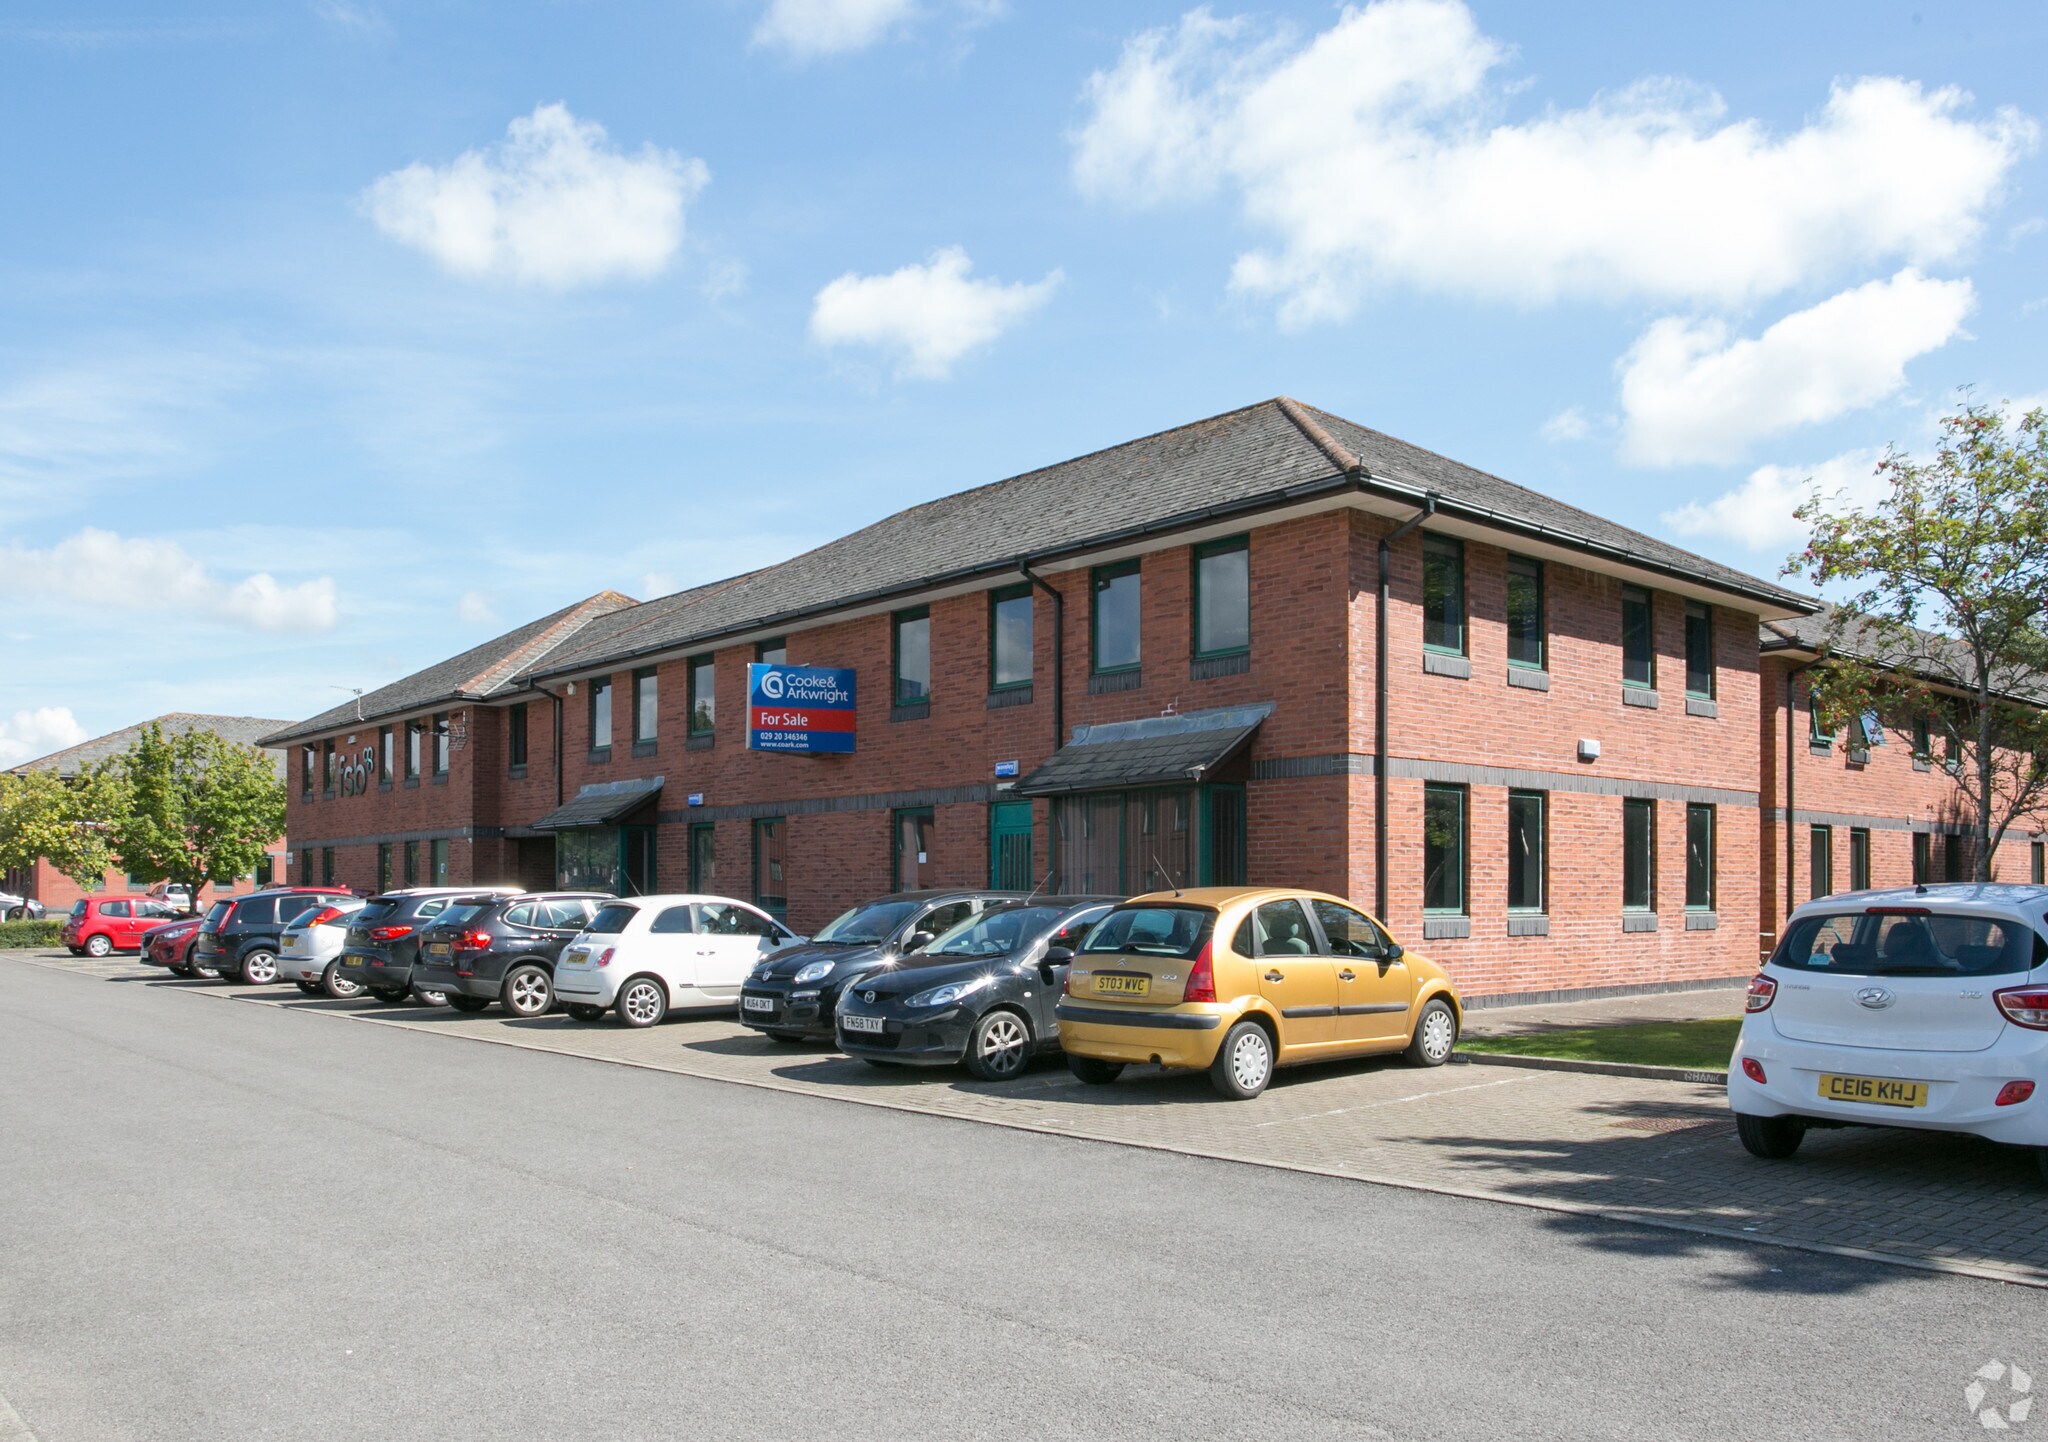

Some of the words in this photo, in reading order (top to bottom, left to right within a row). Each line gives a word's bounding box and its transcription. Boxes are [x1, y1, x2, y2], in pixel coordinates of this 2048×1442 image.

[786, 674, 837, 689] Cooke&
[786, 688, 849, 703] Arkwright
[761, 712, 780, 725] For
[783, 713, 808, 726] Sale
[760, 732, 772, 740] 029
[784, 733, 808, 741] 346346
[760, 741, 809, 749] www.coark.com
[338, 753, 366, 798] fsb
[1099, 977, 1122, 990] ST03
[1124, 978, 1145, 991] WVC
[846, 1016, 864, 1029] FN58
[865, 1018, 879, 1030] TXY
[1831, 1077, 1873, 1097] CE16
[1877, 1081, 1917, 1102] KHJ
